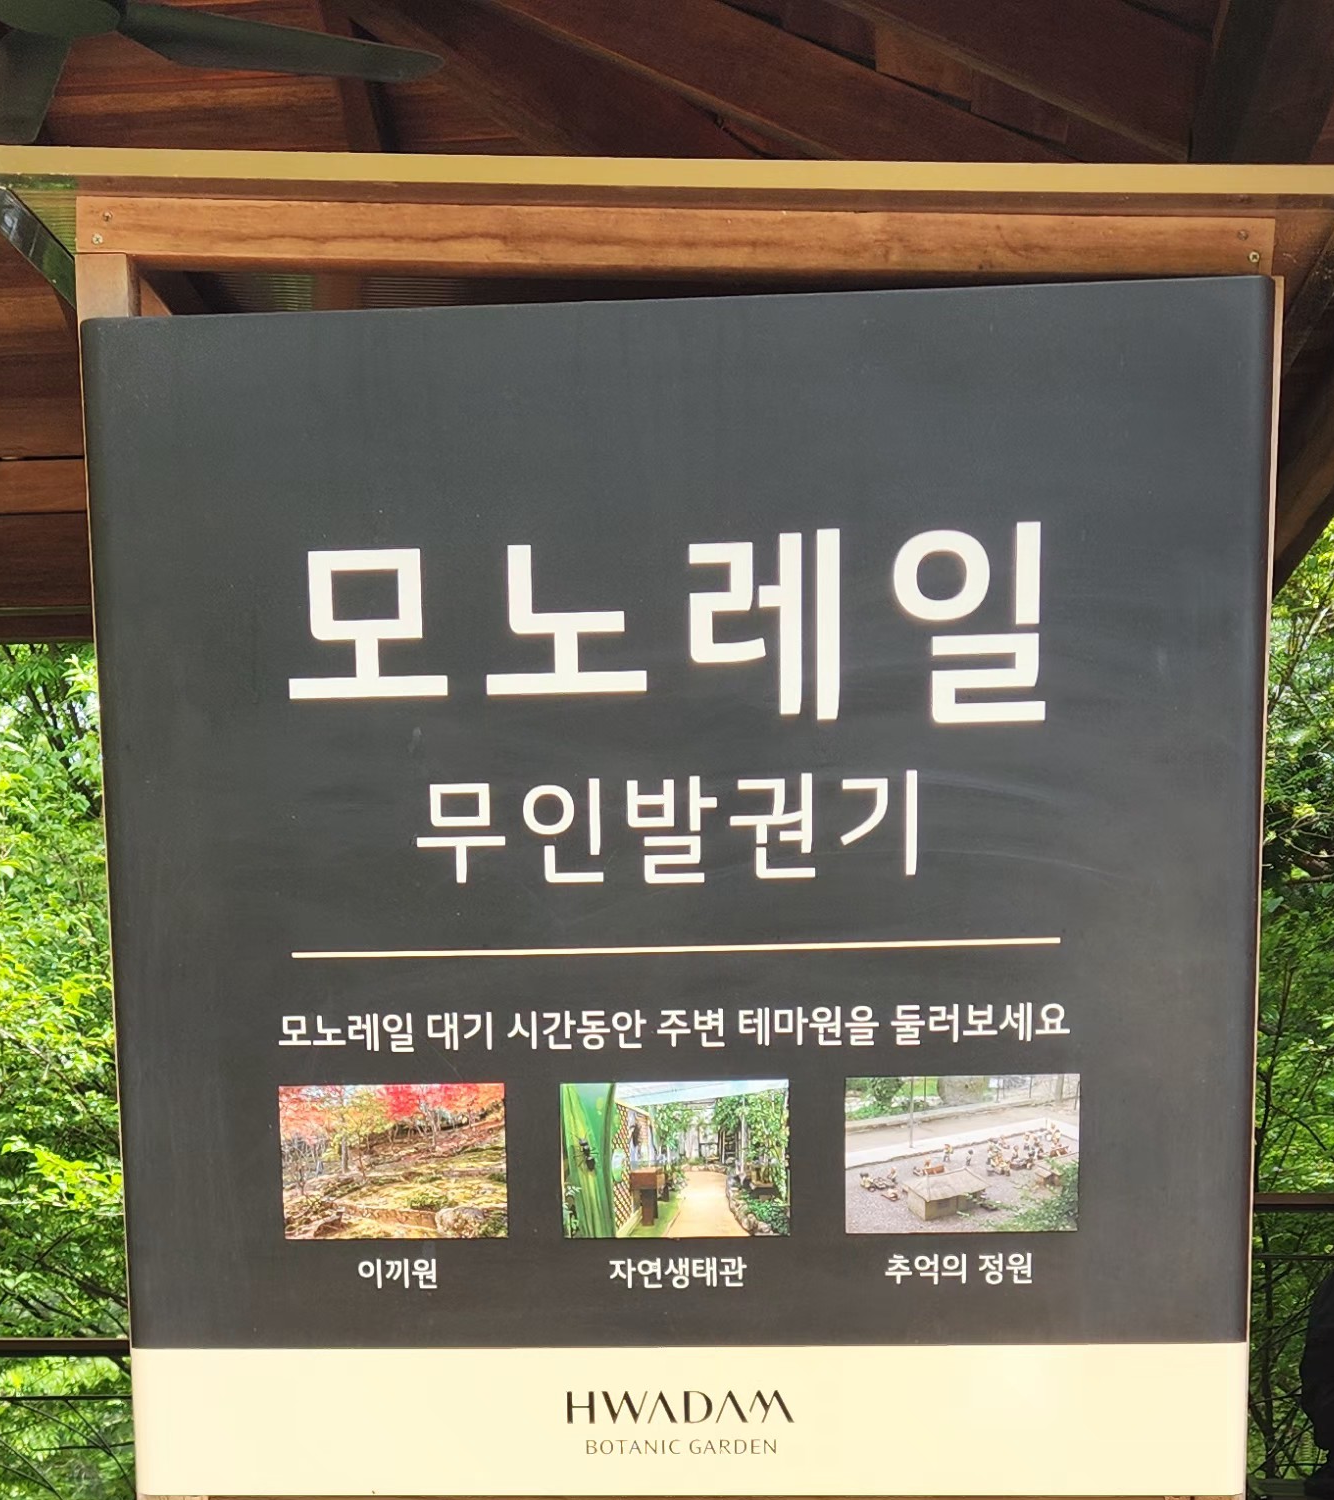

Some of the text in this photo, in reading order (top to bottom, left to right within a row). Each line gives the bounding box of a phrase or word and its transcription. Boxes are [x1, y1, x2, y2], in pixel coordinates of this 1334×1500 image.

[288, 521, 1046, 724] 모노레일
[416, 769, 918, 883] 무인발권기
[278, 1002, 1071, 1053] 모노레일 대기 시간동안 주변 테마원을 둘러보세요
[357, 1258, 438, 1289] 이끼원
[609, 1256, 748, 1289] 자연생태관
[884, 1252, 1034, 1286] 추억의 정원
[566, 1390, 795, 1424] HWADAM
[585, 1438, 777, 1455] BOTANIC GARDEN
